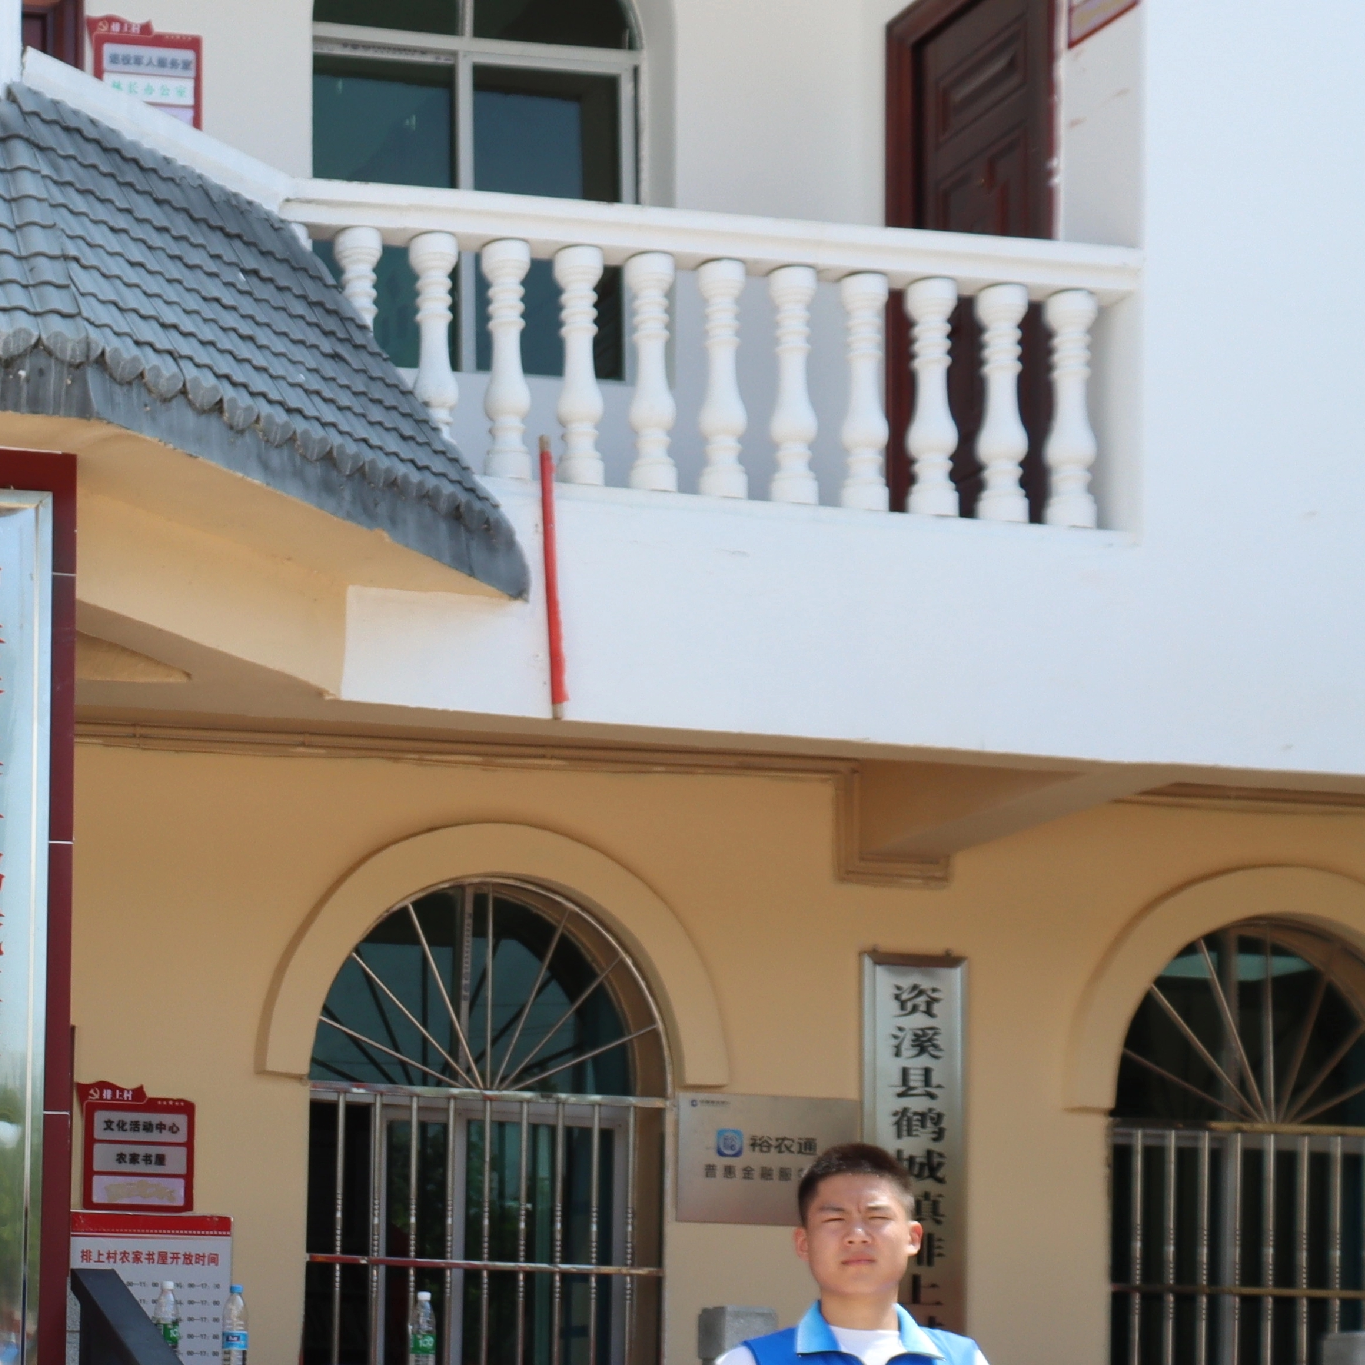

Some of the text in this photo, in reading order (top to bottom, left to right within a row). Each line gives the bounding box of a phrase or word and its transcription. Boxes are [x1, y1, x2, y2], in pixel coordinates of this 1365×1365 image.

[103, 1119, 181, 1135] 文化活动中心
[749, 1135, 818, 1155] 裕农通
[116, 1152, 167, 1167] 农家书屋
[80, 1249, 220, 1267] 排上村农家书屋开放时间
